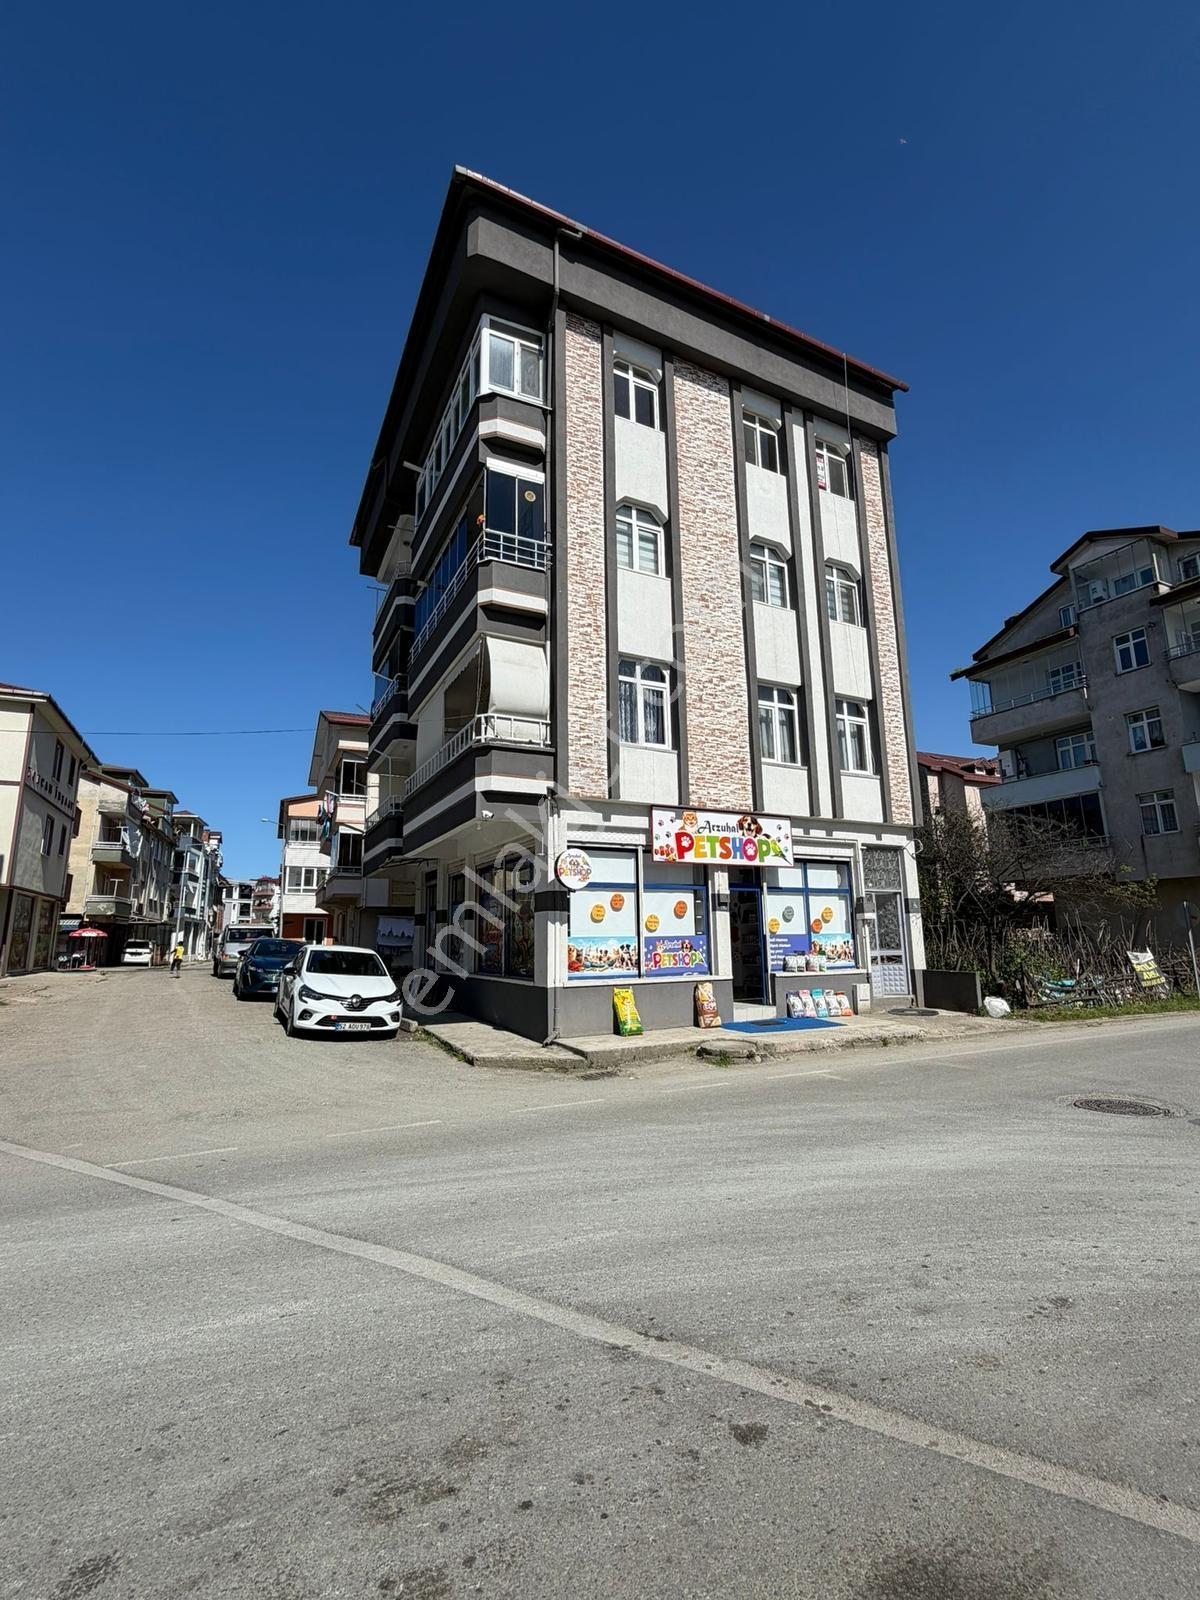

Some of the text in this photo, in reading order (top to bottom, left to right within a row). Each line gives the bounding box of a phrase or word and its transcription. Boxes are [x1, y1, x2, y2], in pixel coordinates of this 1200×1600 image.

[697, 820, 740, 834] Arzuhal
[675, 832, 771, 863] PETSHOP
[558, 867, 592, 877] PETSHOP
[652, 951, 698, 969] PETSHOP
